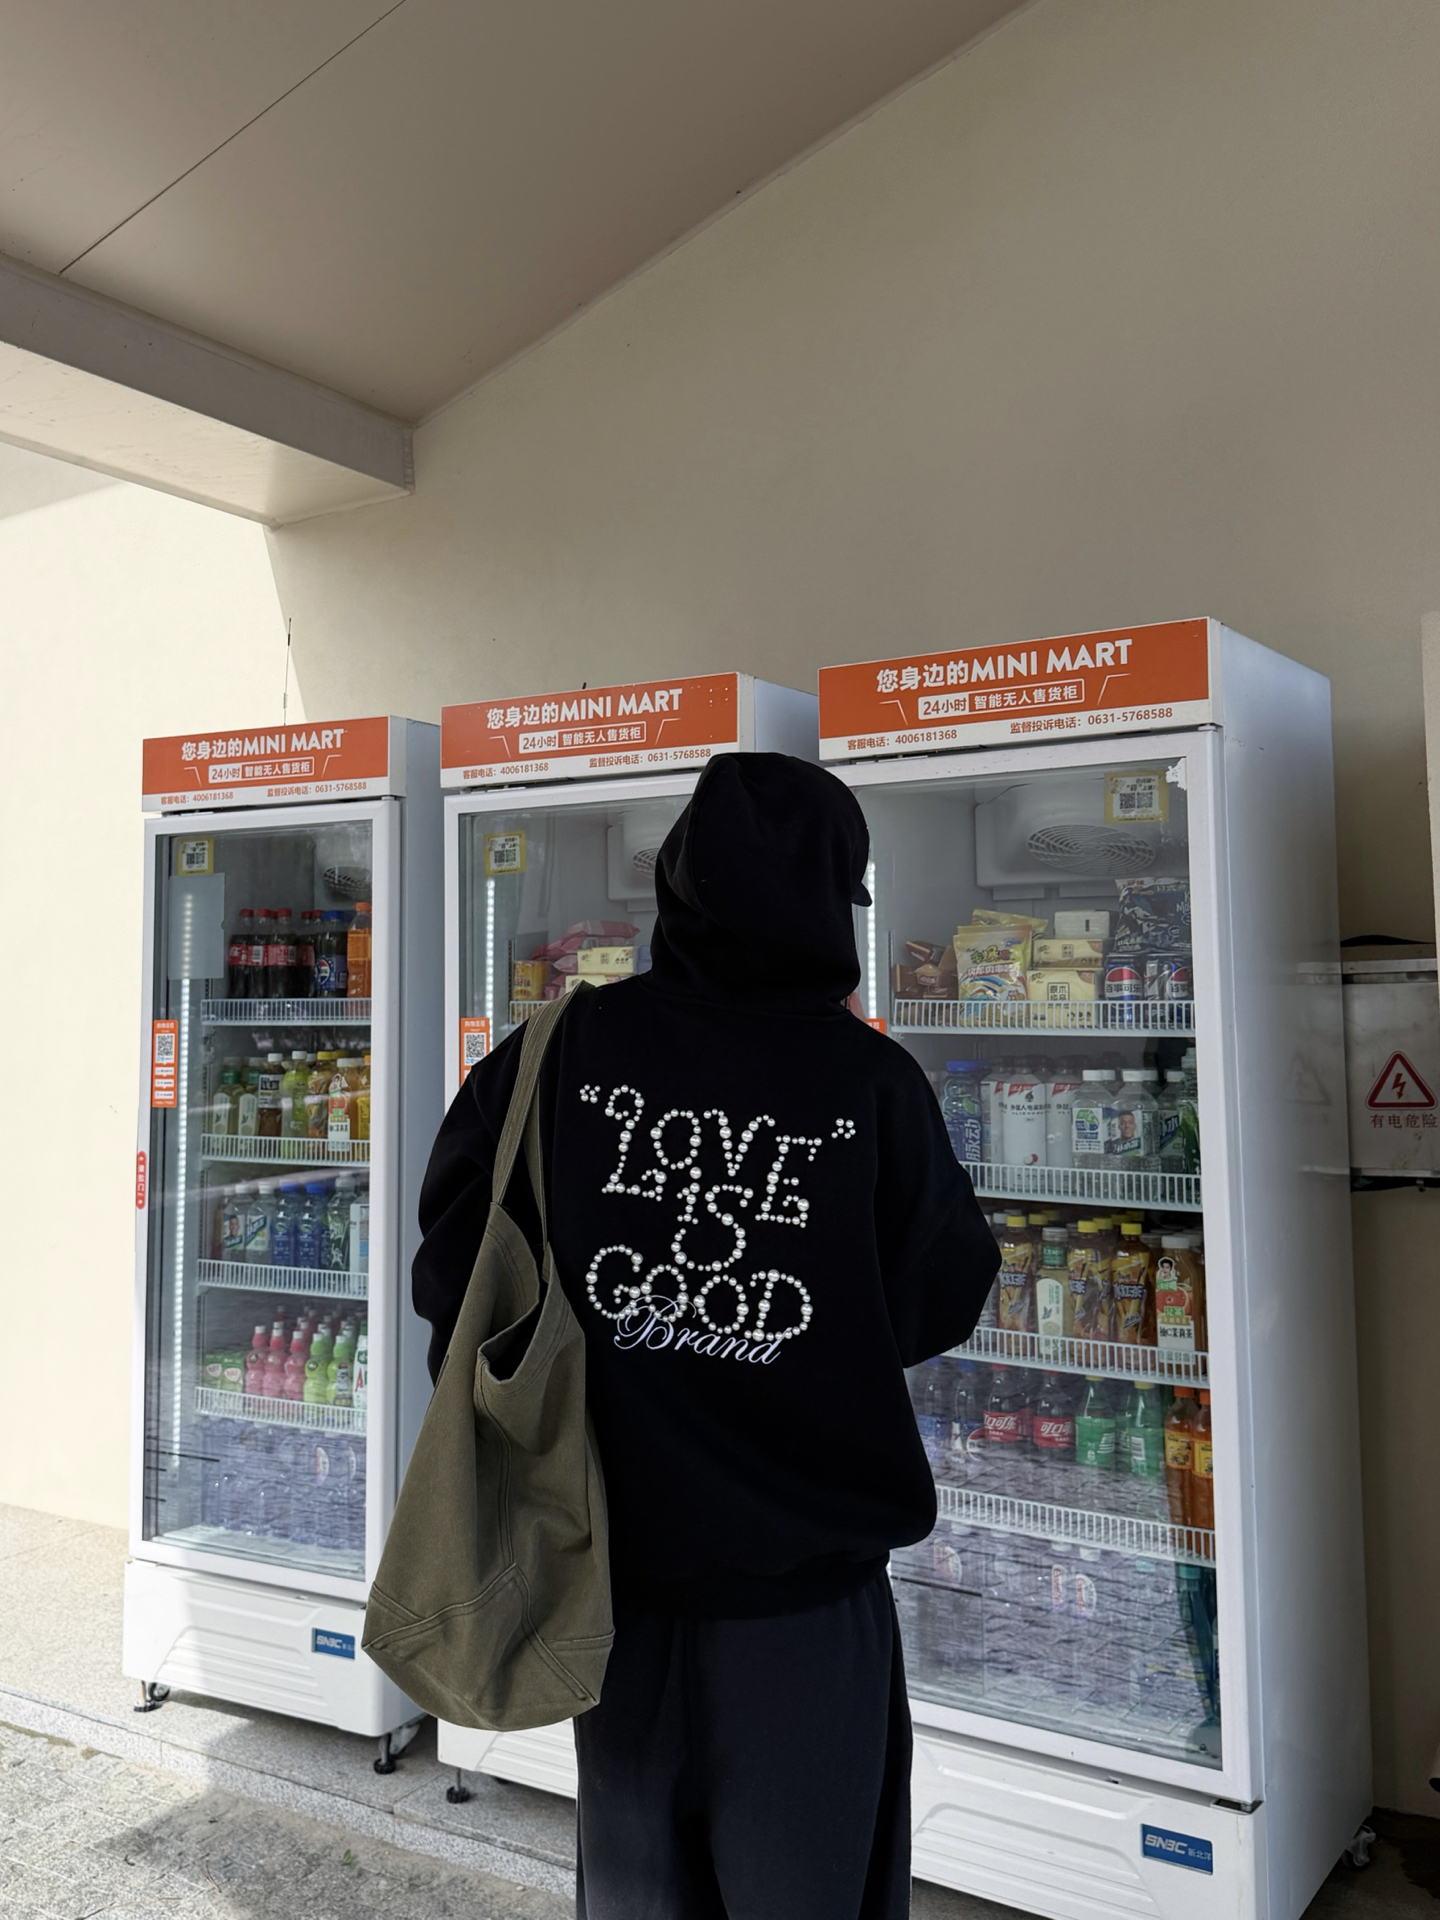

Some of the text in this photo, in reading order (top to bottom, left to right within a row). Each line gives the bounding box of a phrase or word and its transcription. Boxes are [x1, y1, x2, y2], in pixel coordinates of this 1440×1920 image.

[1046, 638, 1132, 674] MART
[618, 688, 683, 716] MART
[973, 684, 1078, 710] 智能无人售货柜
[291, 728, 344, 752] MART
[562, 727, 642, 746] 智能无人售货柜
[244, 763, 311, 778] 智能无人售货柜
[1106, 983, 1141, 993] 百事可乐
[1370, 1113, 1438, 1129] 有电危险
[670, 1166, 754, 1271] IS
[585, 1244, 814, 1342] GOOD
[613, 1294, 793, 1365] Brand
